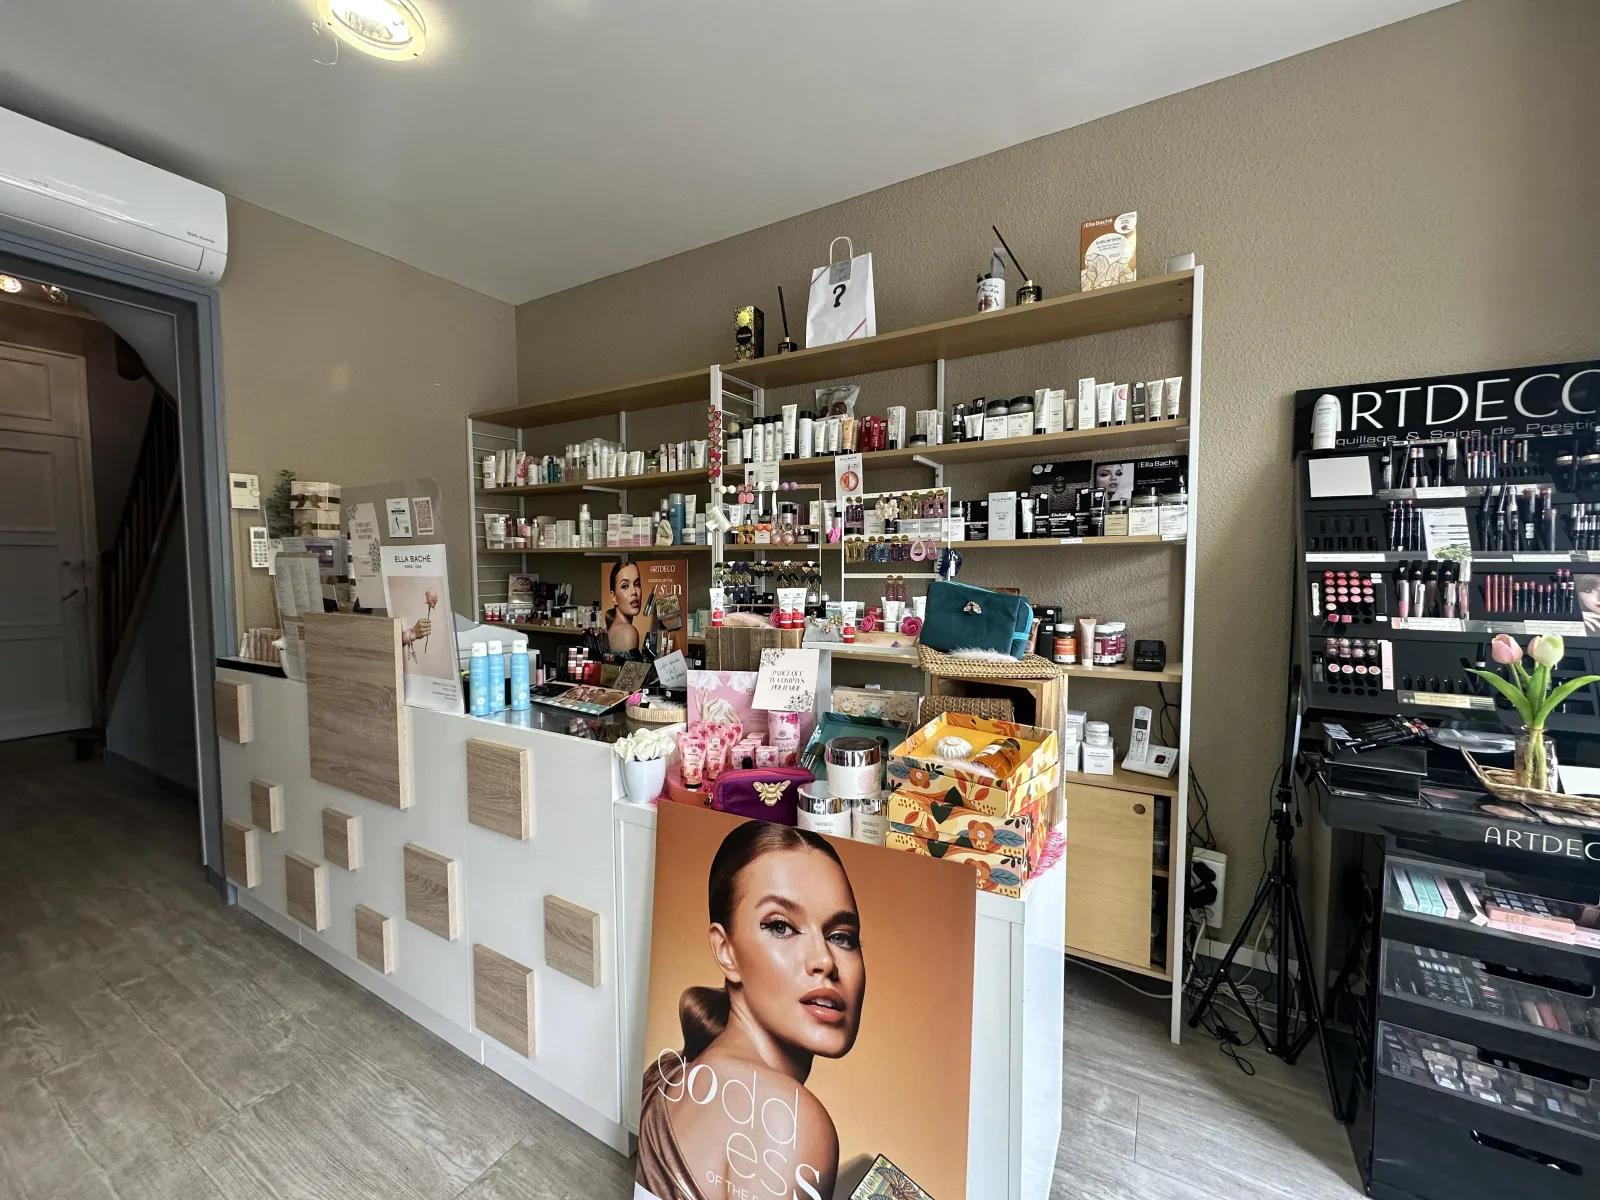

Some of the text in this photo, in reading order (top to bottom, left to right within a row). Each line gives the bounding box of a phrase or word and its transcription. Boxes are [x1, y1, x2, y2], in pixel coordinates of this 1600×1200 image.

[833, 283, 847, 308] ?
[1336, 435, 1397, 446] quillage
[1406, 431, 1421, 441] &
[1430, 428, 1482, 439] Soins
[1492, 425, 1515, 436] de
[1154, 459, 1179, 467] Baché
[410, 554, 431, 562] BACHÉ
[650, 564, 676, 573] ARTDECO
[659, 583, 682, 595] sun
[706, 1170, 723, 1187] OF
